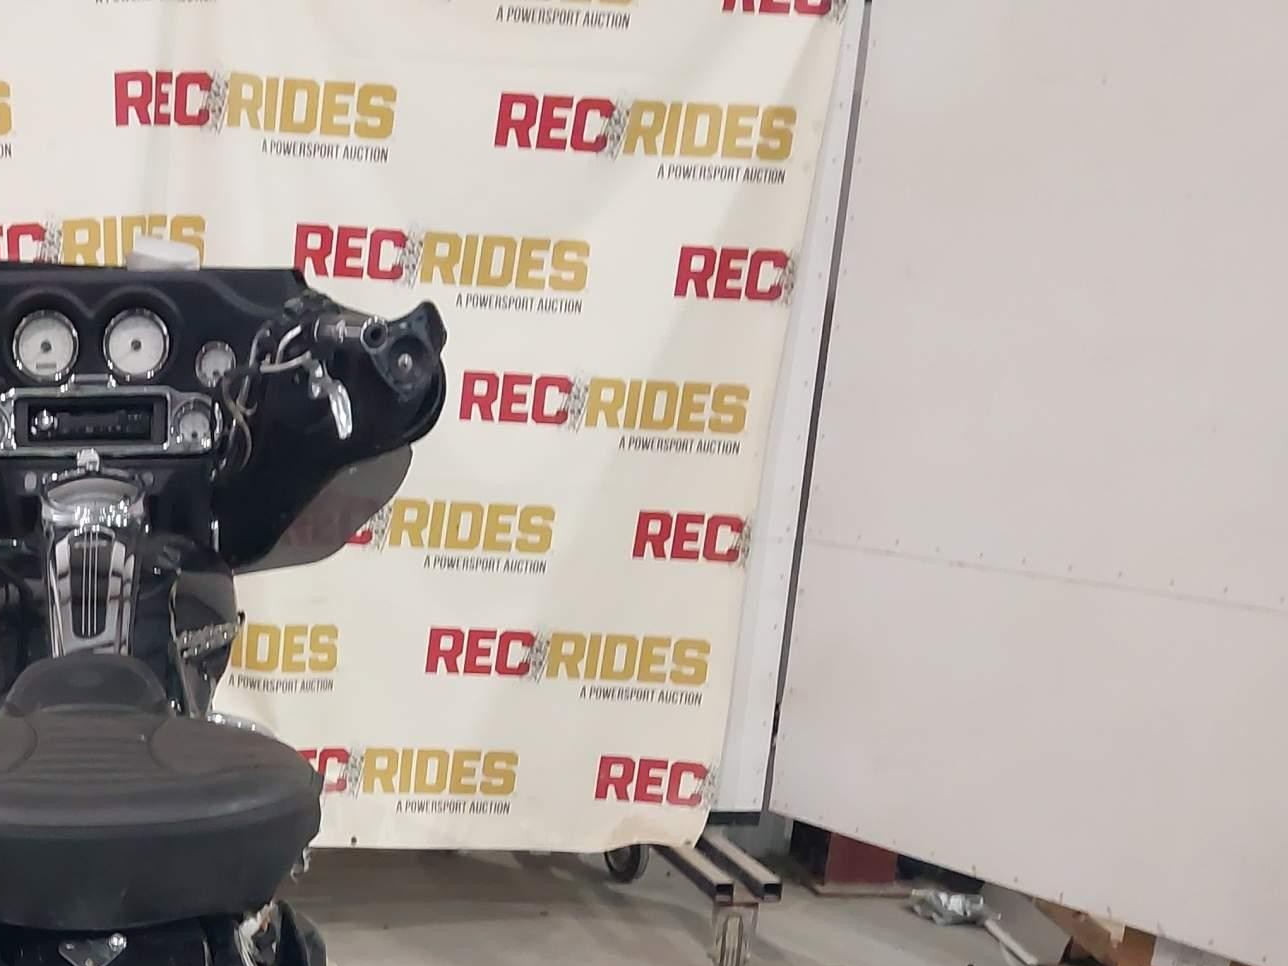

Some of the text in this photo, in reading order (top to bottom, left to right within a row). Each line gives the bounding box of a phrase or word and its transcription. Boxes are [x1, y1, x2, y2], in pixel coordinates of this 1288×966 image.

[495, 3, 631, 30] A POWERSPORT AUCTION
[114, 71, 397, 140] REC RIDES
[494, 93, 797, 161] REC RIDES
[261, 138, 389, 164] A POWERSPORT AUCTION
[656, 162, 786, 185] A POWERSPORT AUCTION
[294, 224, 591, 292] REC RIDES
[674, 245, 789, 302] REC
[455, 292, 583, 315] A POWERSPORT AUCTION
[458, 371, 751, 434] REC RIDES
[618, 434, 741, 456] A POWERSPORT AUCTION
[387, 499, 556, 554] RIDES
[632, 510, 745, 563] REC
[423, 553, 547, 575] A POWERSPORT AUCTION
[229, 622, 339, 674] IDES
[424, 626, 712, 687] REC RIDES
[227, 672, 334, 694] A POWERSPORT AUCTION
[579, 684, 703, 707] A POWERSPORT AUCTION
[360, 746, 520, 797] RIDES
[595, 755, 707, 807] REC
[395, 799, 511, 816] A POWERSPORT AUCTION
